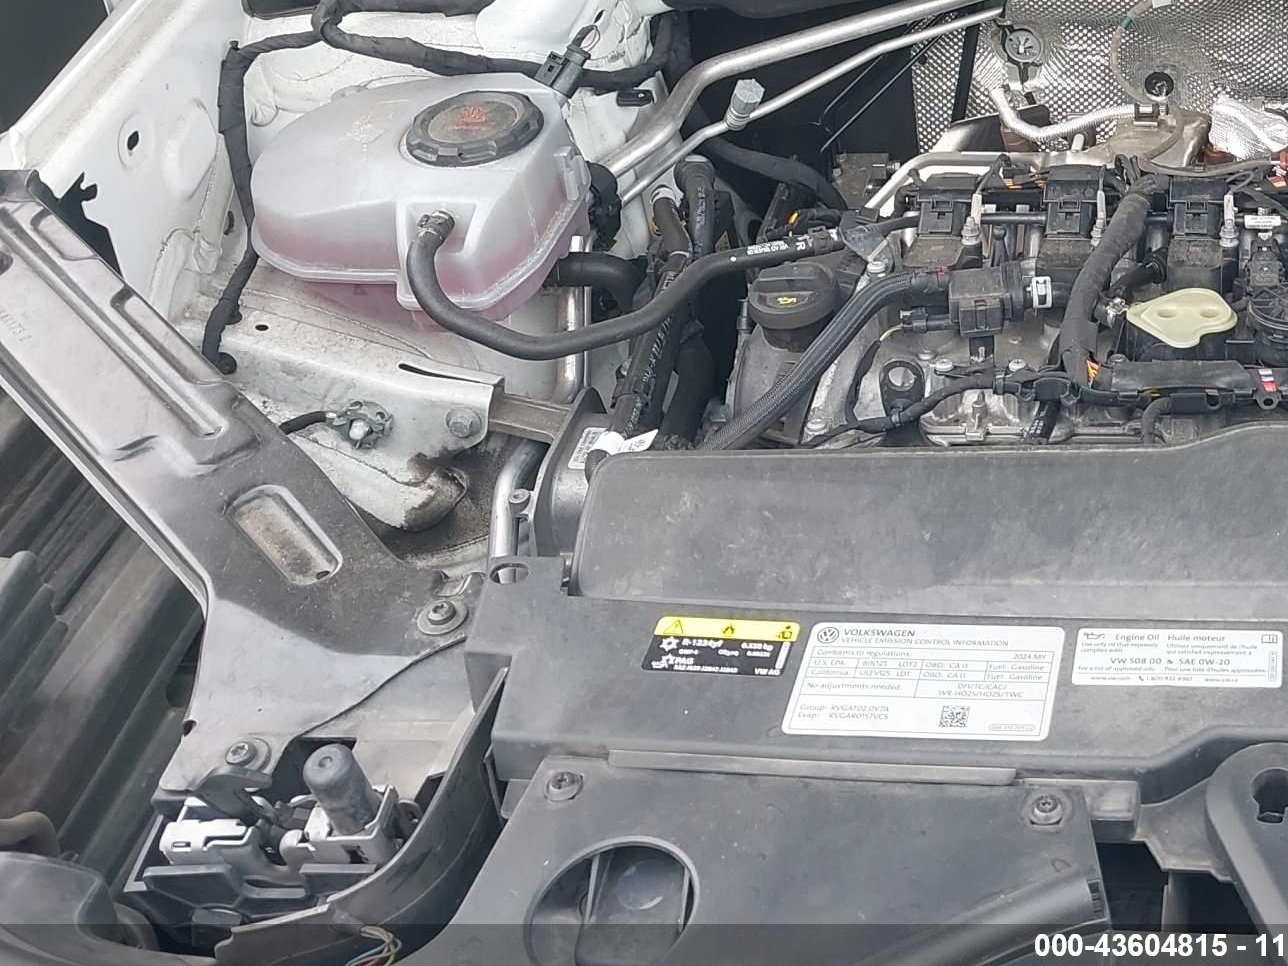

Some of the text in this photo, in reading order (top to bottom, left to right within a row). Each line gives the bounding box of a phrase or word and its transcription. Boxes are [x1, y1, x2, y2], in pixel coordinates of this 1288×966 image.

[843, 629, 915, 638] VOLKSWAGEN
[1115, 633, 1160, 642] Engine Oil
[1167, 634, 1225, 642] Huile moteur
[840, 637, 873, 645] VEHICLE
[913, 638, 951, 646] CONTROL
[952, 639, 1009, 647] INFORMATION
[1012, 653, 1047, 661] 2024 MY
[1110, 657, 1128, 665] VW
[1129, 657, 1147, 665] 508
[1149, 657, 1163, 665] 00
[1178, 658, 1198, 666] SAE
[1198, 658, 1231, 666] 0W-20
[946, 671, 959, 679] CA
